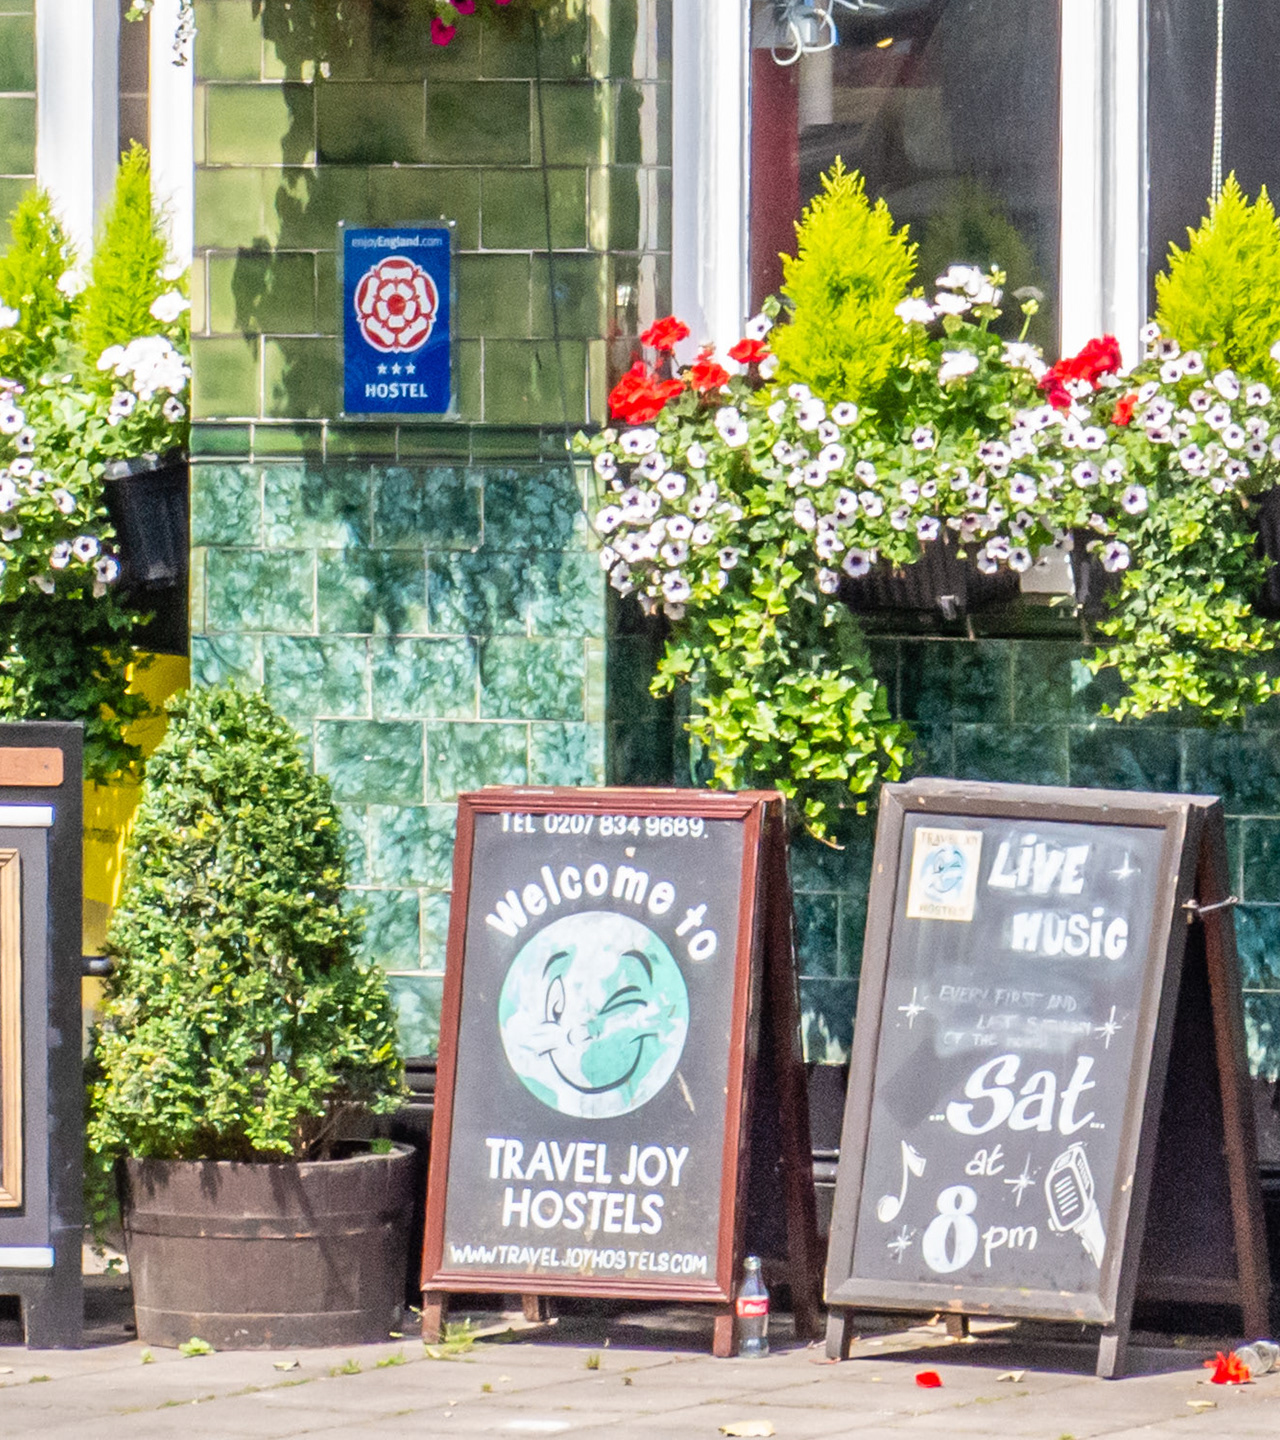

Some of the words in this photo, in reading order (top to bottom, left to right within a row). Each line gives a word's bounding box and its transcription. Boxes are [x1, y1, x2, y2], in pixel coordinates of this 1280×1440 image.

[365, 382, 428, 398] HOSTEL
[500, 812, 536, 834] TEL
[599, 814, 641, 836] 834
[485, 862, 676, 938] Welcome
[675, 903, 718, 962] to
[485, 1137, 612, 1184] TRAVEL
[619, 1143, 690, 1187] JOY
[965, 1143, 1005, 1176] at
[502, 1186, 665, 1235] HOSTELS
